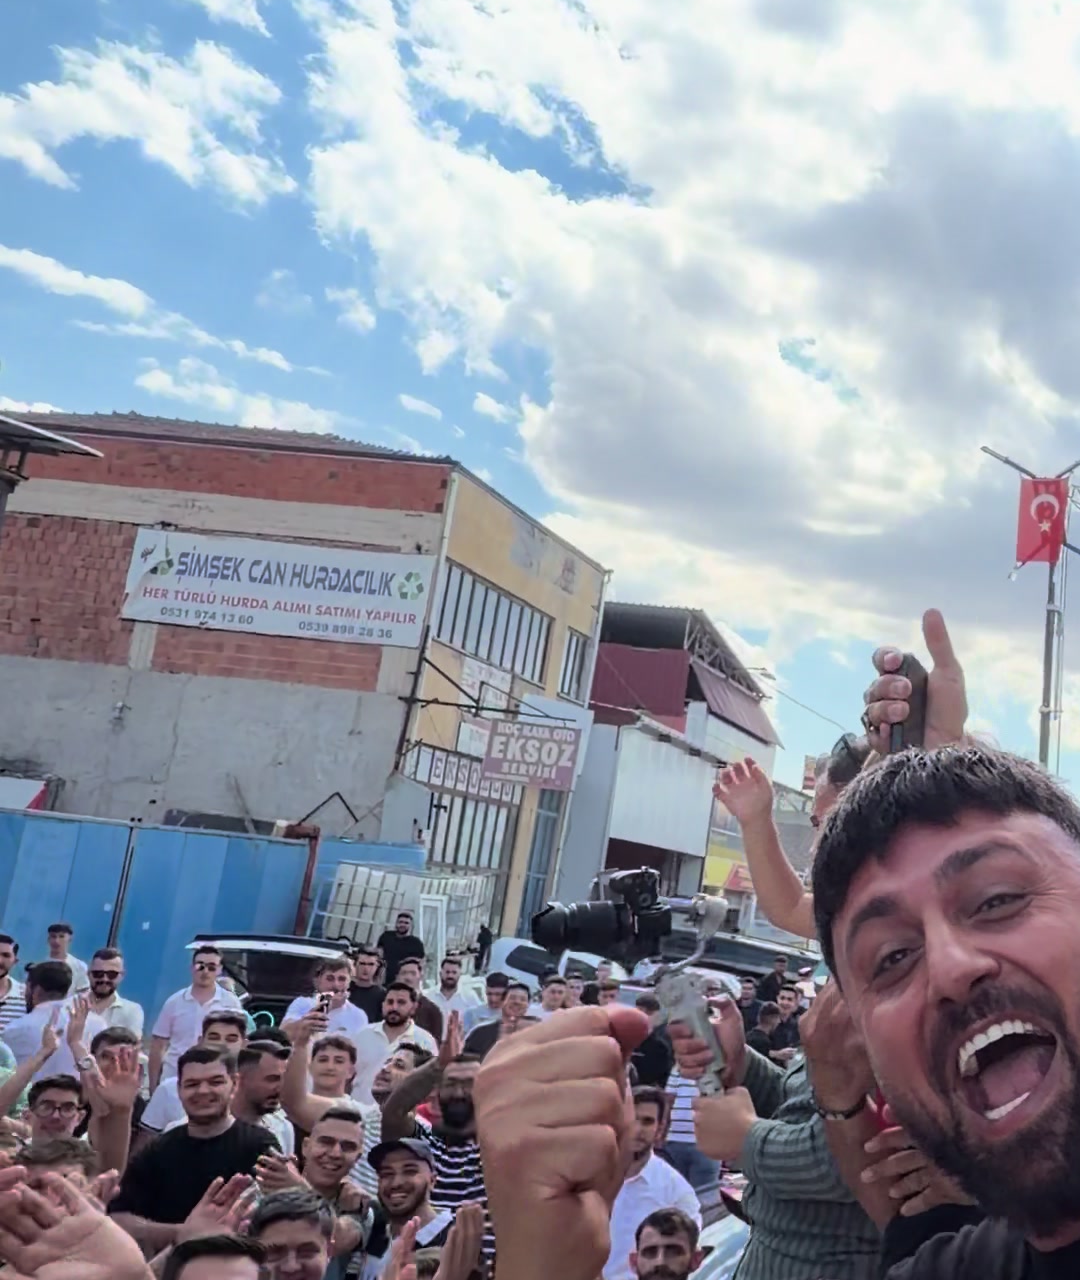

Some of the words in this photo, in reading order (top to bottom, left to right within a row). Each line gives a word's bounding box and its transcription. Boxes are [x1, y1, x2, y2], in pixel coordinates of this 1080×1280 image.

[175, 545, 245, 588] ŞİMŞEK
[248, 559, 288, 587] CAN
[289, 563, 396, 597] HURDACILIK
[142, 586, 169, 600] HER
[173, 587, 217, 605] TÜRLÜ
[220, 595, 269, 611] HURDA
[272, 600, 311, 615] ALIMI
[315, 604, 360, 620] SATIMI
[365, 609, 416, 625] YAPILIR
[491, 735, 575, 767] EKSOZ
